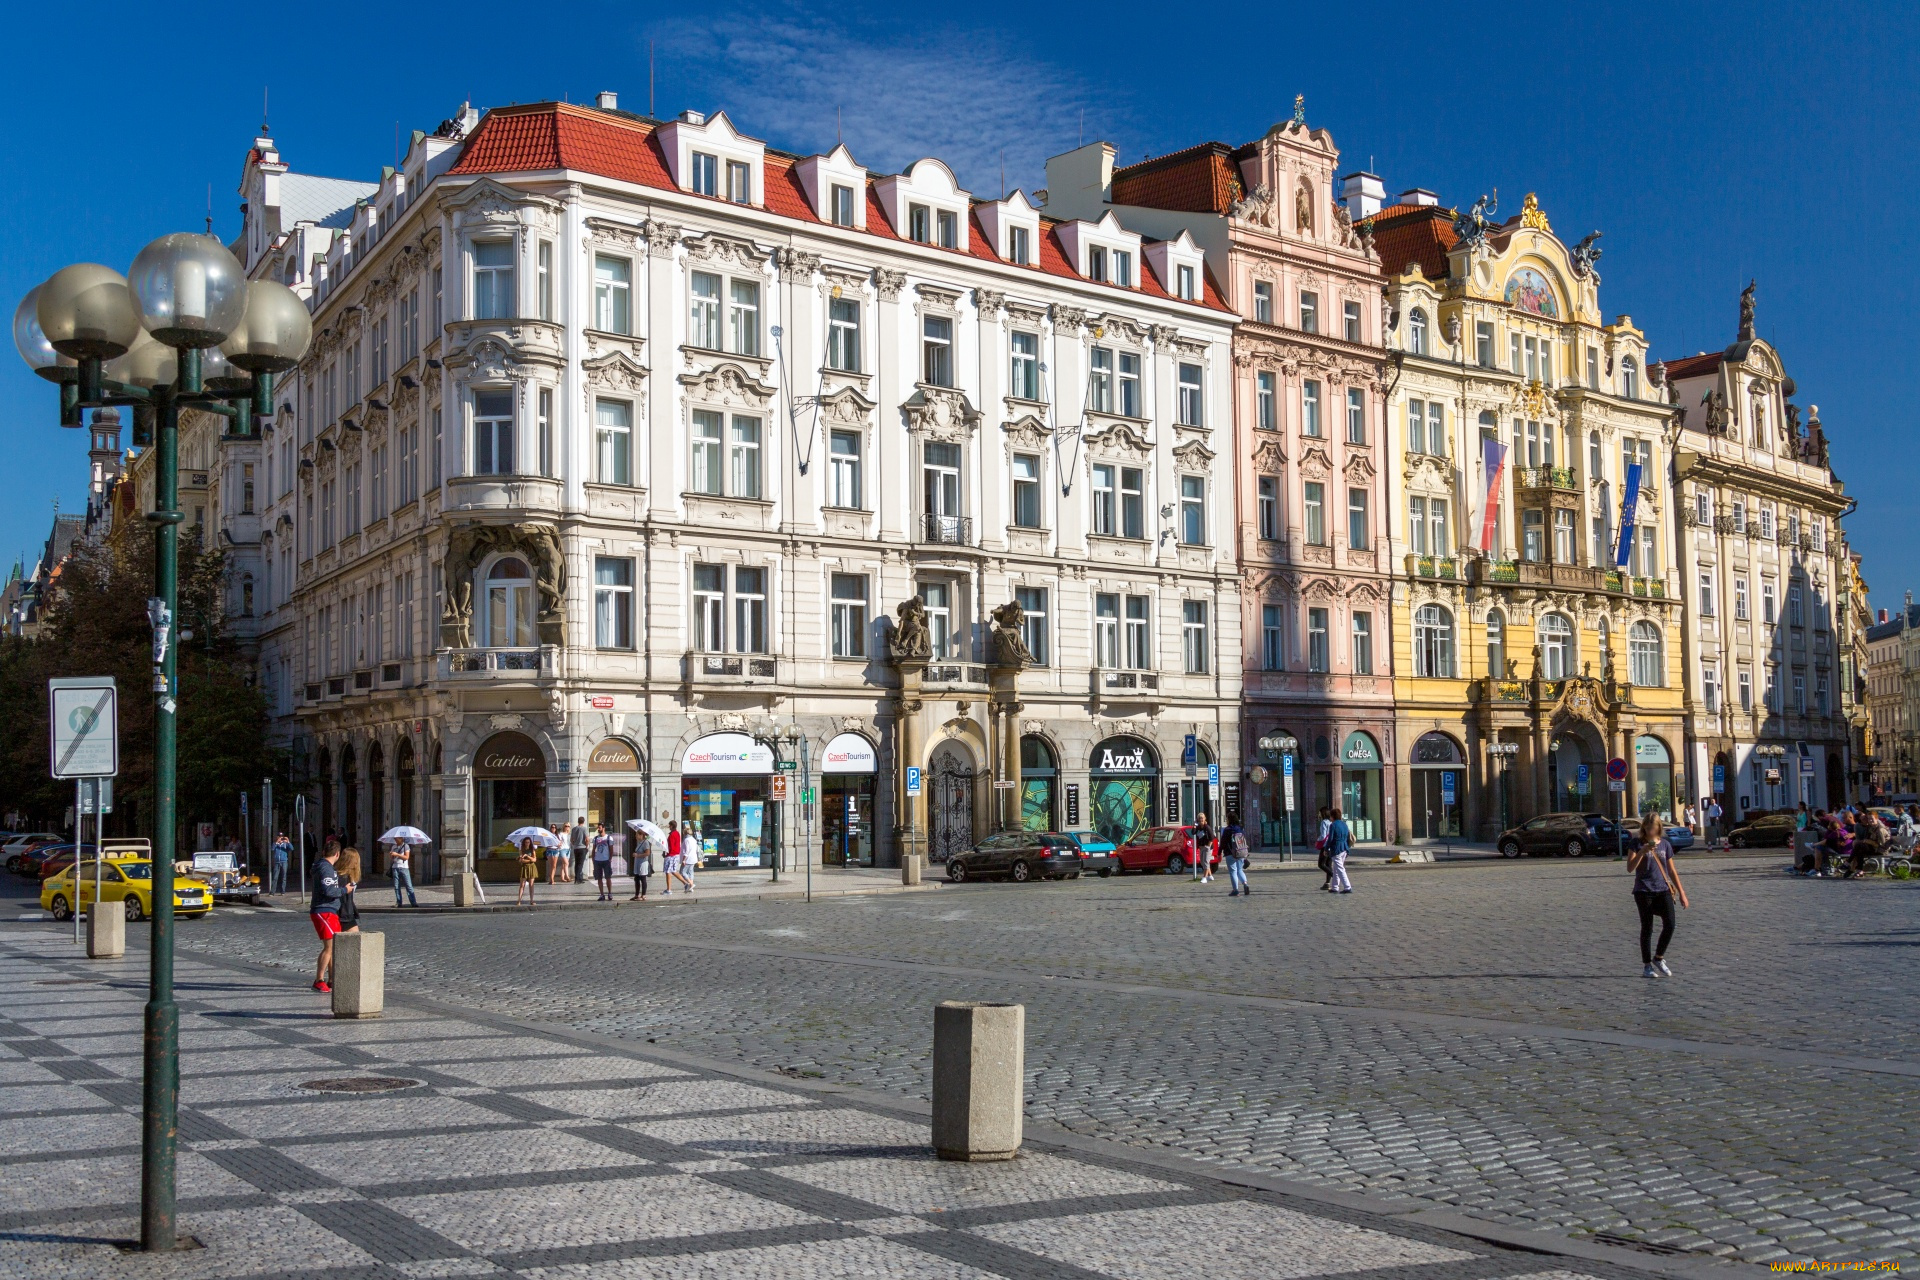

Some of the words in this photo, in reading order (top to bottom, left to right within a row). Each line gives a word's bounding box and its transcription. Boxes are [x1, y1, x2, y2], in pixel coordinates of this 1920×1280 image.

[593, 751, 632, 763] Cartier
[690, 753, 737, 761] CzechTourism
[828, 752, 870, 760] CzechTourism
[1348, 750, 1372, 758] OMEGA
[484, 753, 535, 768] Cartier
[910, 770, 917, 783] P
[1210, 767, 1216, 778] P
